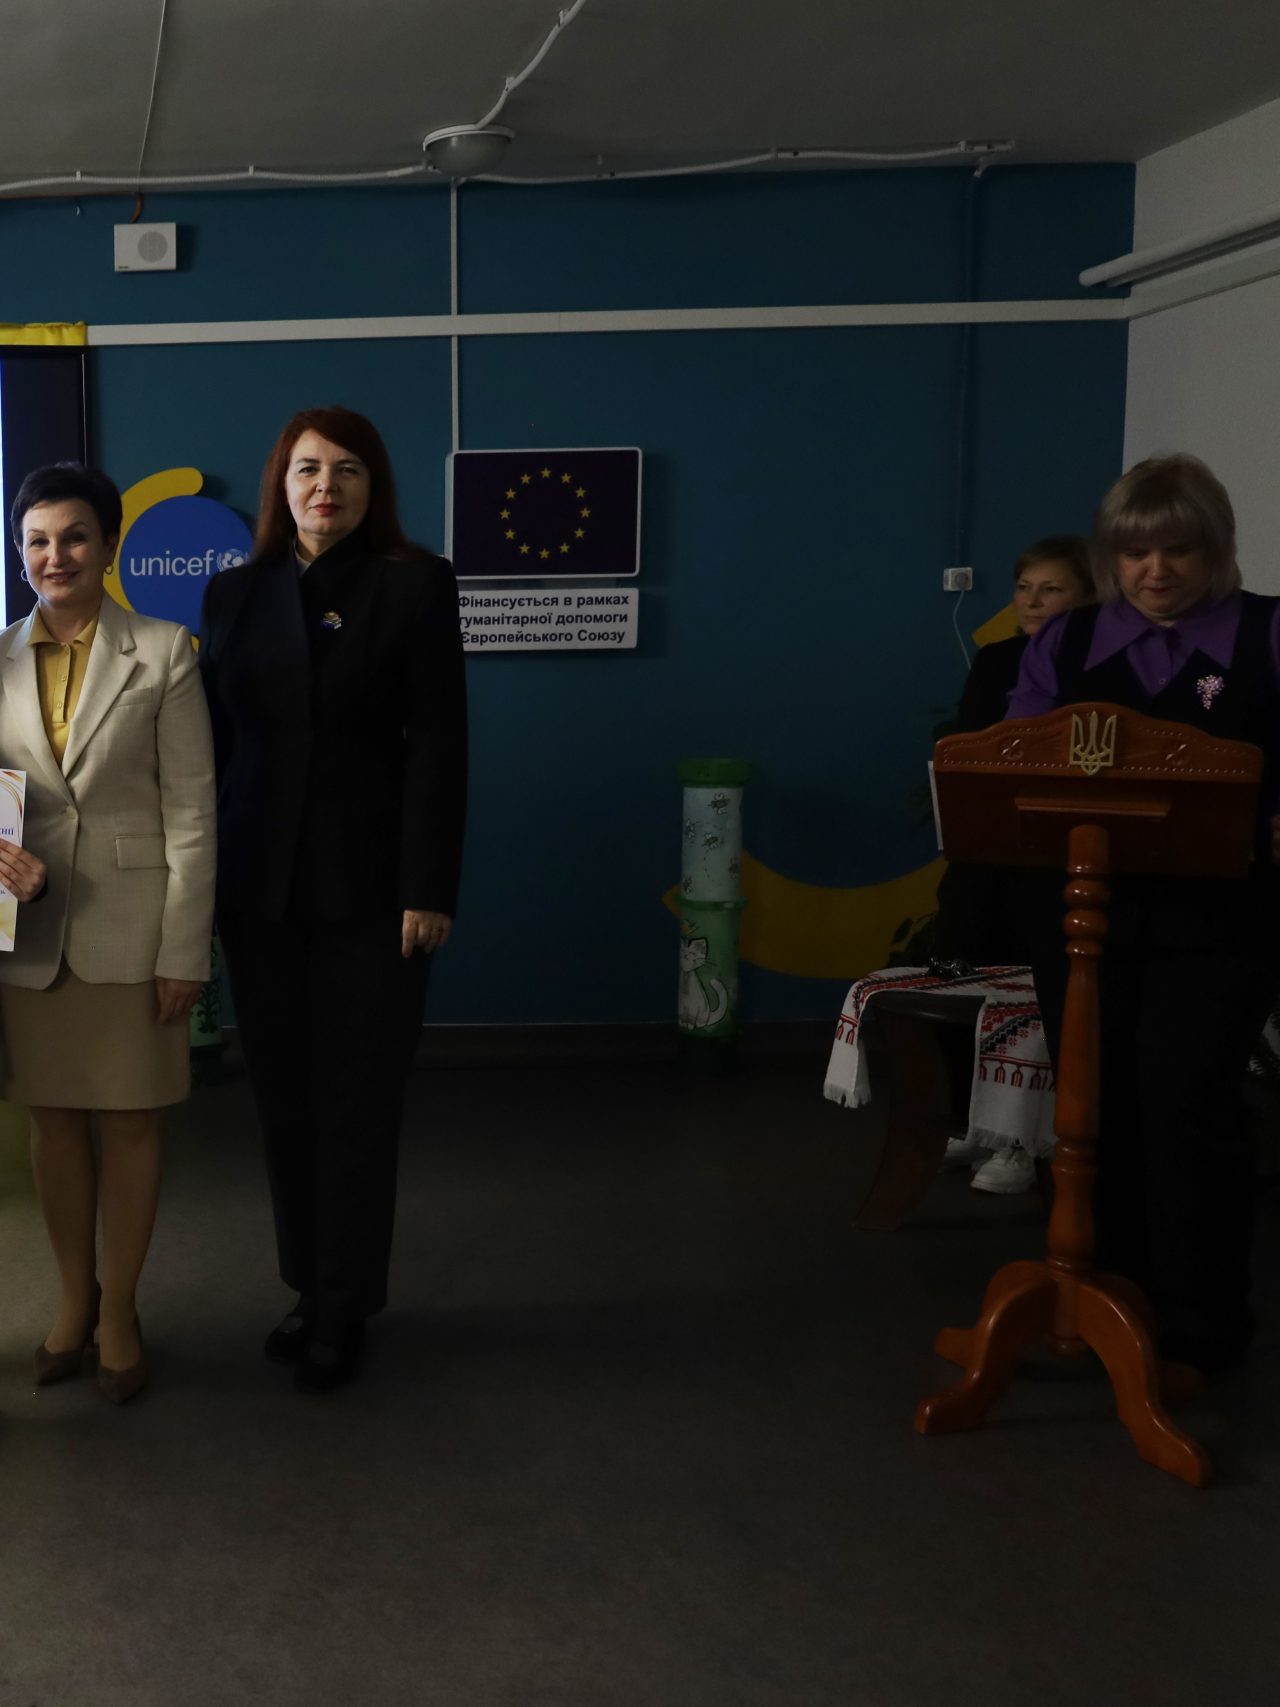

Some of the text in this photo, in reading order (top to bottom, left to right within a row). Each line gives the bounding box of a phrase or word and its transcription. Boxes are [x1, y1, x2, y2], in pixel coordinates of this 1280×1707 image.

[130, 549, 214, 576] unicef
[459, 595, 629, 610] Фінансується в рамках
[459, 612, 628, 628] гуманітарної допомоги
[461, 629, 625, 646] Європейського Союзу
